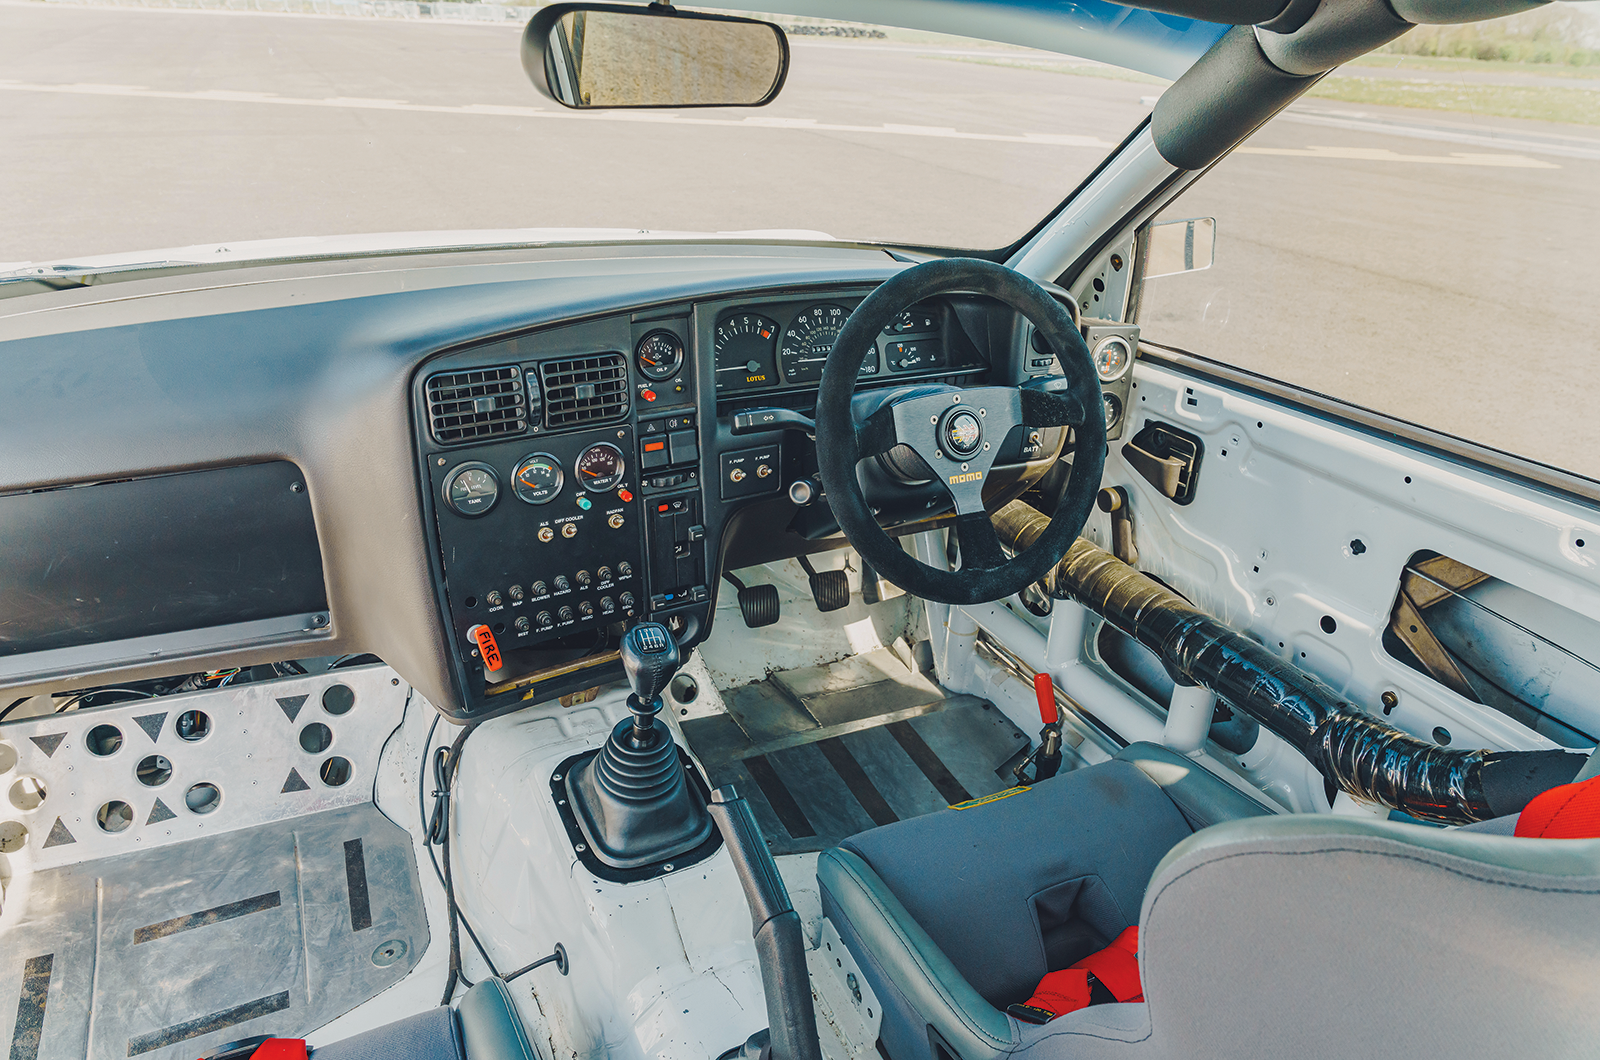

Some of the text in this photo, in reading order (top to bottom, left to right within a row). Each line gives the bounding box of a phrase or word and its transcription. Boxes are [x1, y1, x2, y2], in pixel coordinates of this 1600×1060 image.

[813, 308, 823, 317] 80
[829, 308, 841, 316] 100
[730, 319, 735, 327] 4
[744, 316, 749, 324] 5
[757, 319, 762, 327] 6
[798, 315, 808, 323] 60
[718, 327, 724, 335] 3
[770, 325, 775, 333] 7
[867, 347, 876, 355] 60
[864, 366, 876, 374] 180
[746, 375, 766, 383] LOTUS
[597, 583, 615, 591] COOLER
[531, 594, 551, 602] BLOWER
[479, 631, 499, 667] FIRE
